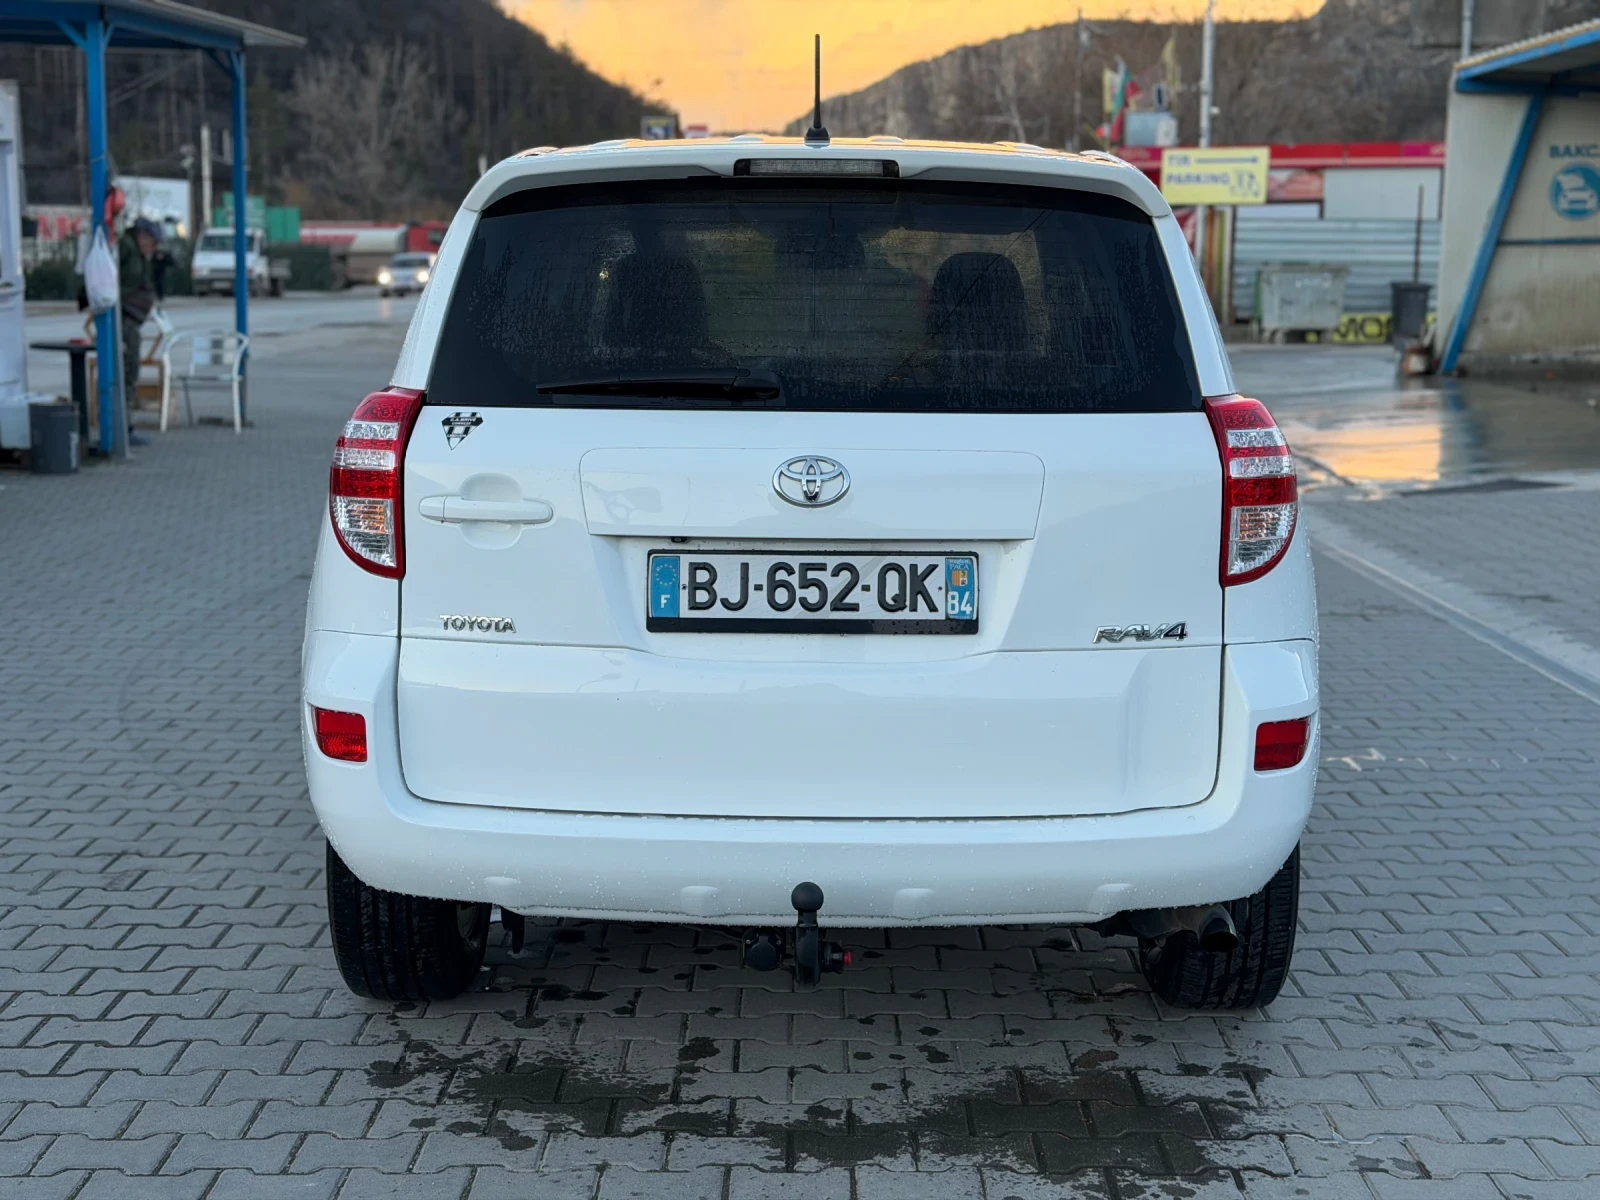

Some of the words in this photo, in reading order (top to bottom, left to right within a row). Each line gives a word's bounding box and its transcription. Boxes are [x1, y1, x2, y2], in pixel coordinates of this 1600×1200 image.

[1166, 172, 1230, 184] PARKING
[688, 562, 938, 612] BJ-652-QK
[660, 594, 671, 609] F
[947, 591, 972, 615] 84
[439, 614, 517, 633] TOYOTA
[1092, 621, 1188, 644] RAV4
